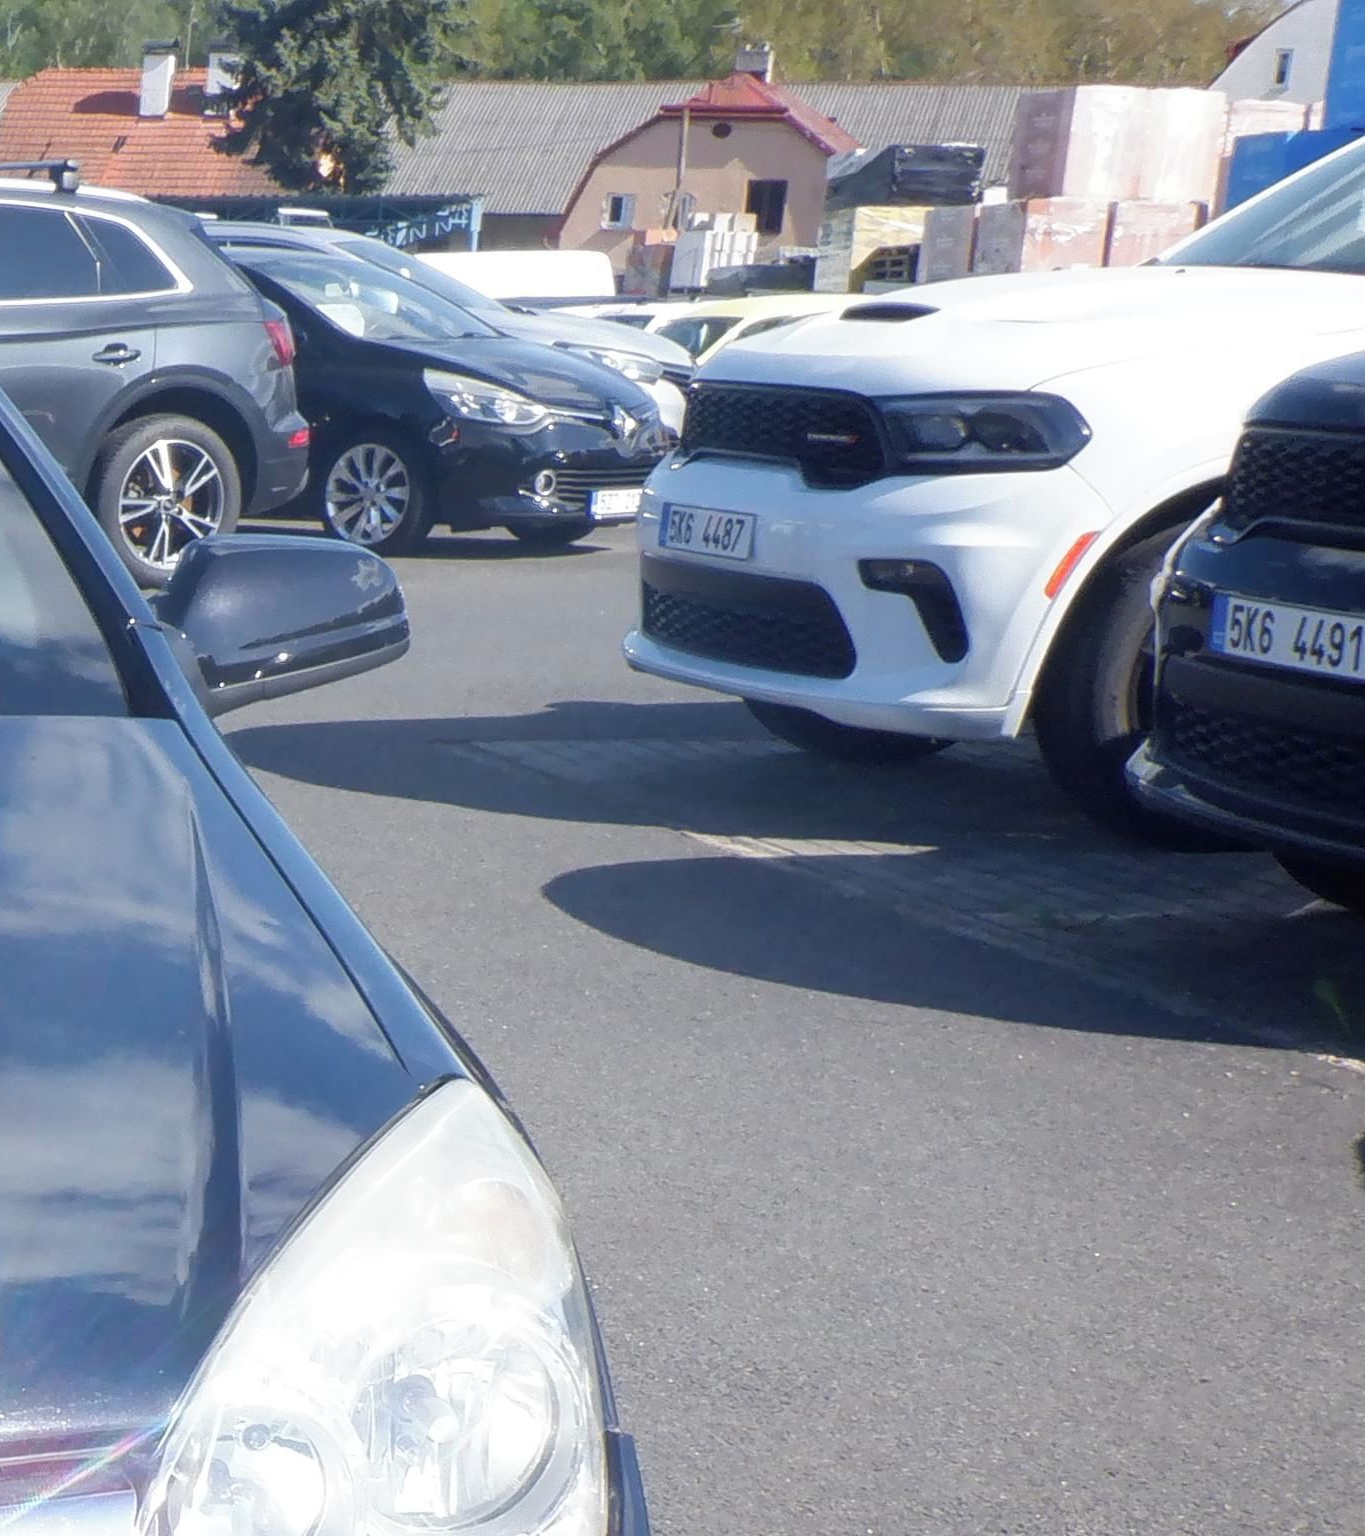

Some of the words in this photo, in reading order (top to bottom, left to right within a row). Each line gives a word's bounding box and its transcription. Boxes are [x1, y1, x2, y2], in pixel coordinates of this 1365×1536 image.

[669, 509, 695, 545] 5K6
[702, 515, 745, 551] 4487
[1229, 604, 1275, 654] 5K6
[1293, 615, 1364, 671] 4491
